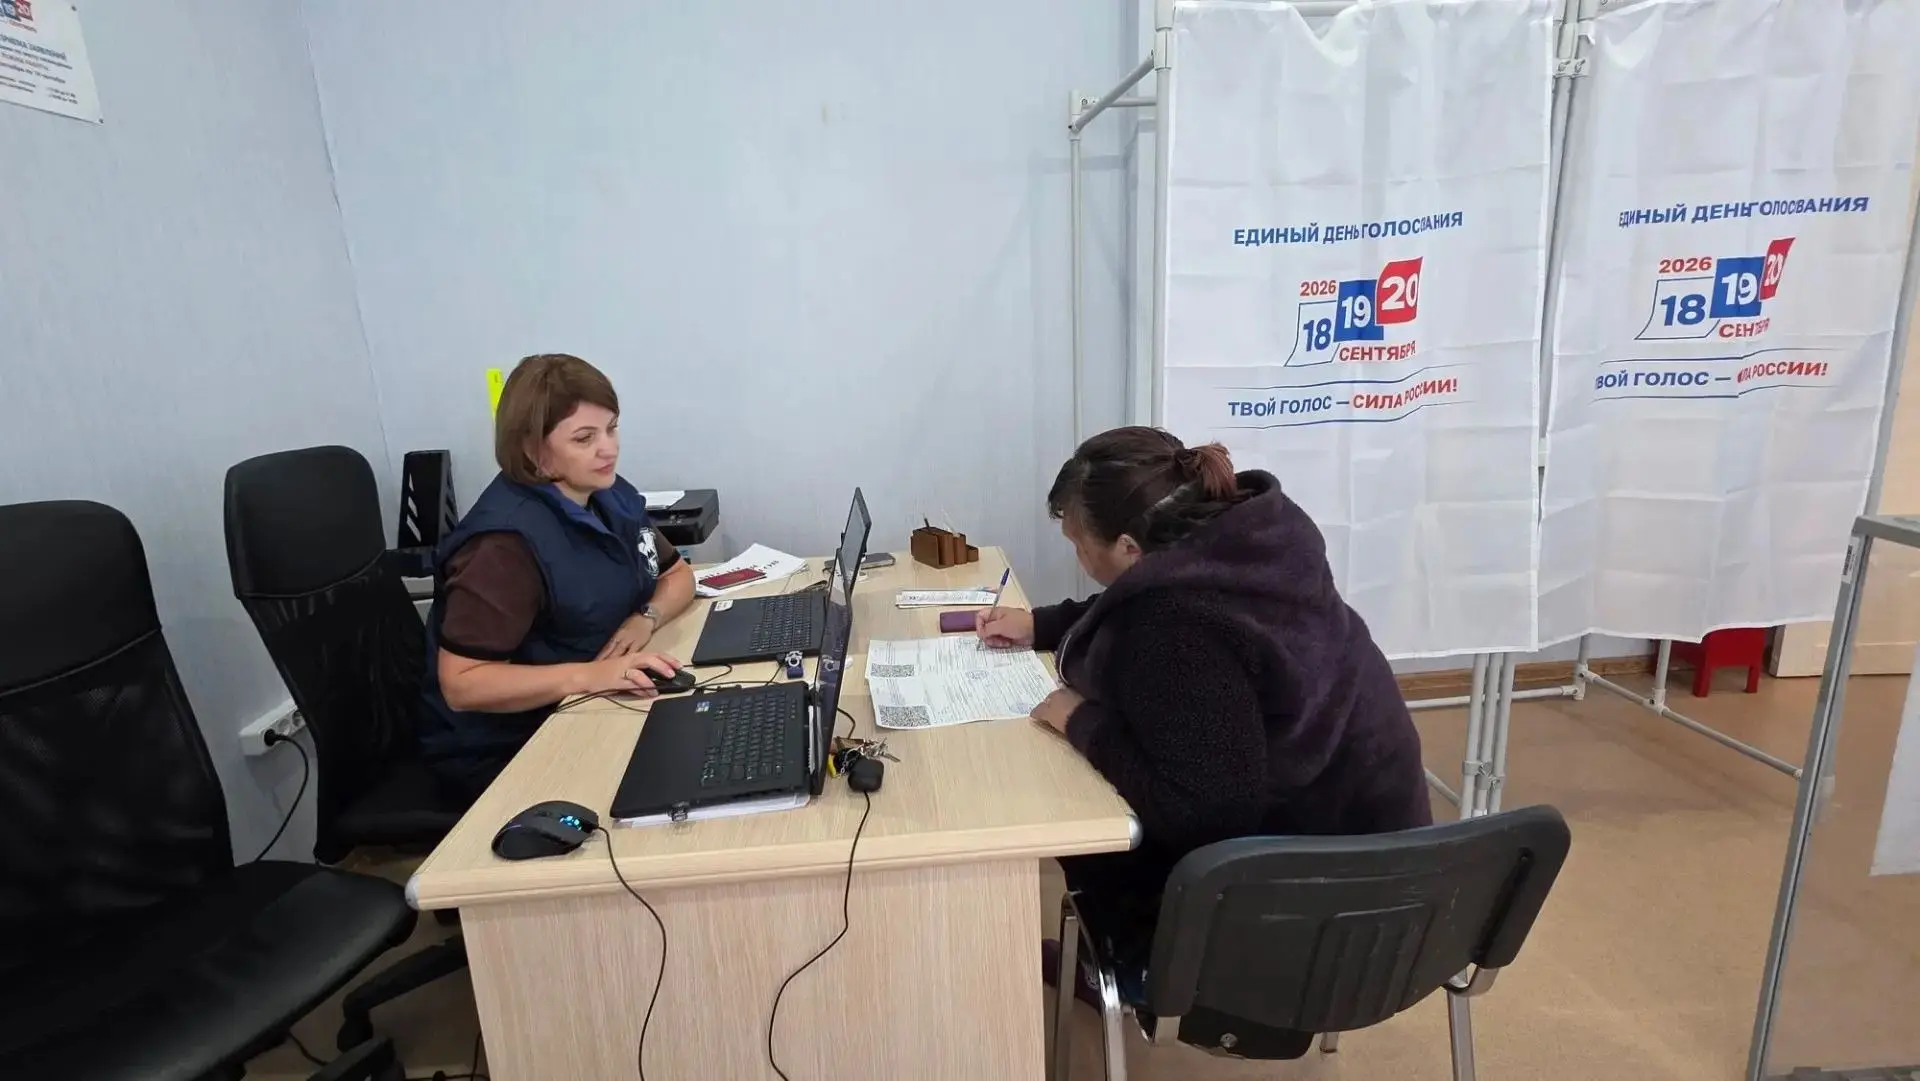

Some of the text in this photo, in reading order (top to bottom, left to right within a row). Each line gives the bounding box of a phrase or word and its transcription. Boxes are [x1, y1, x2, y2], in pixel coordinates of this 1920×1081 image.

[1618, 197, 1870, 228] ЕДИНЫЙ ДЕНЬ ГОЛОСВАНИЯ
[1234, 222, 1319, 246] ЕДИНЫЙ
[1323, 225, 1360, 244] ДЕНЬ
[1659, 257, 1712, 273] 2026
[1300, 280, 1337, 296] 2026
[1661, 253, 1784, 326] 18 19 20
[1303, 273, 1418, 352] 18 19 20
[1339, 340, 1416, 361] СЕНТЯБРЯ
[1595, 370, 1628, 390] ВОЙ
[1633, 372, 1709, 386] ГОЛОС
[1751, 361, 1828, 378] РОССИИ!
[1228, 397, 1276, 416] ТВОЙ
[1280, 396, 1332, 414] ГОЛОС
[1353, 393, 1402, 409] СИЛА
